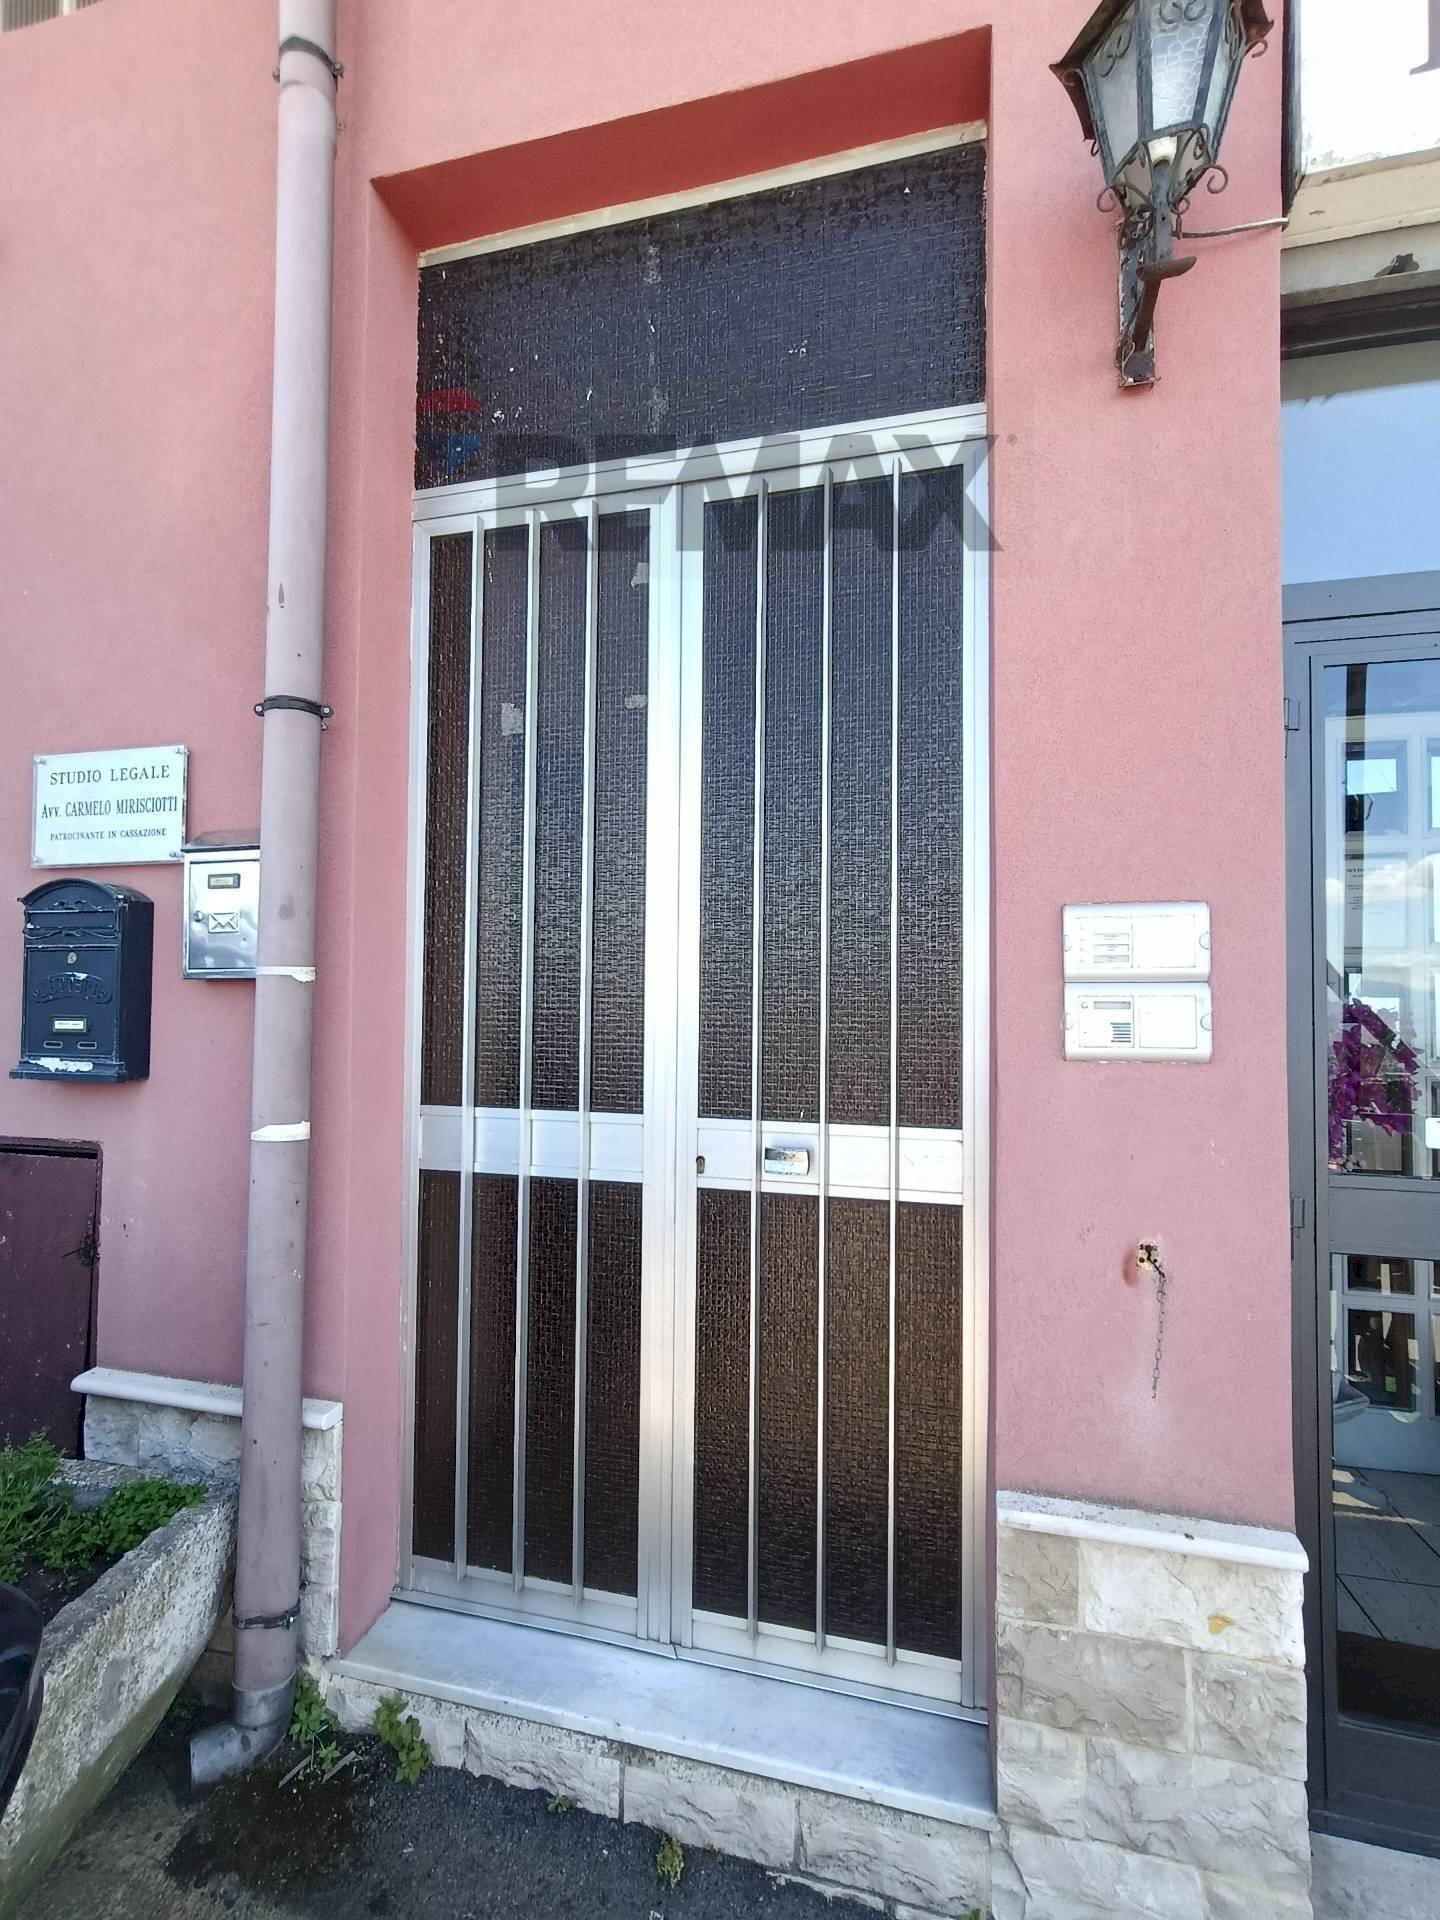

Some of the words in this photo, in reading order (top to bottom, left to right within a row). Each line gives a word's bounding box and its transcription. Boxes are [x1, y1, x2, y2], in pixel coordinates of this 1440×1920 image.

[50, 769, 102, 786] STUDIO
[110, 764, 170, 782] LEGALE
[65, 799, 112, 818] CARMELO
[116, 796, 178, 815] MIRISCIOTTI
[50, 830, 105, 841] PATROCINANTE
[108, 830, 117, 839] IN
[120, 828, 167, 838] CASSAZIONE
